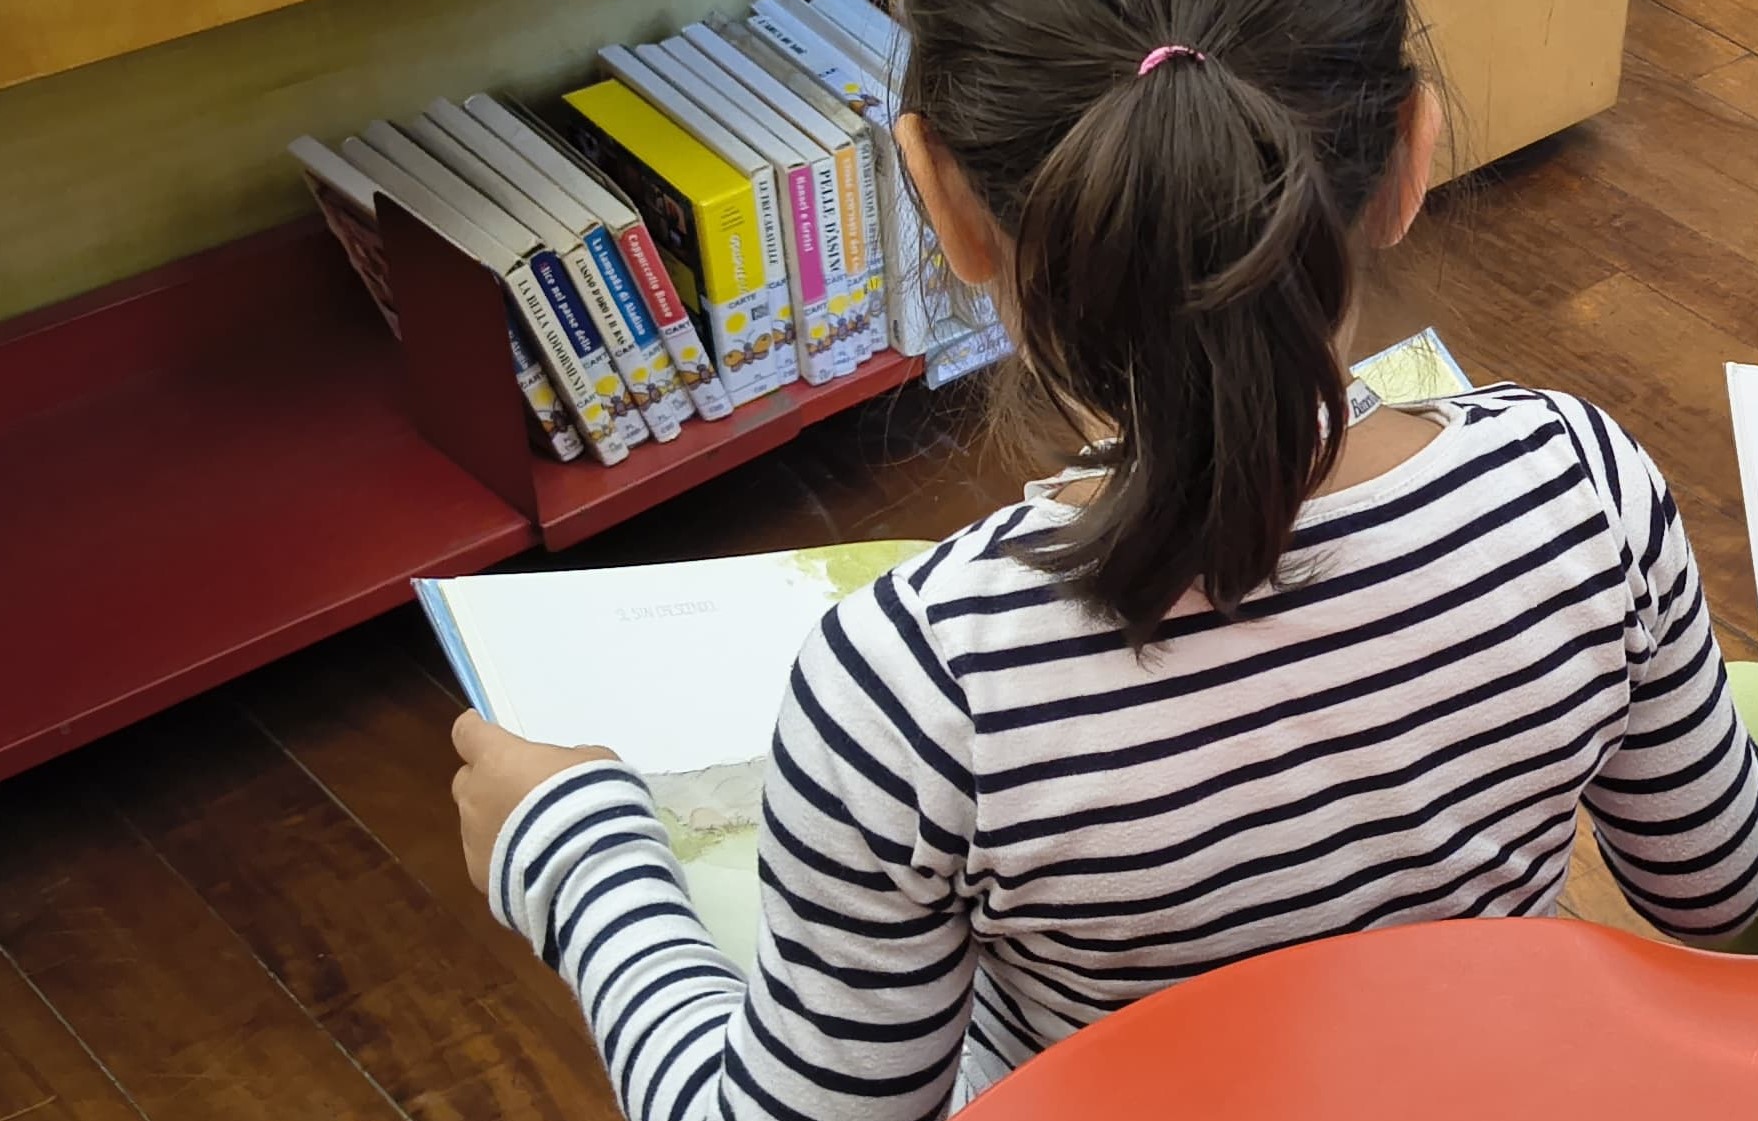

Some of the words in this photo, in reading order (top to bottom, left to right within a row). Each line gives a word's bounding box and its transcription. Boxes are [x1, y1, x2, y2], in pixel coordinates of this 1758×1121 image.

[818, 168, 837, 221] PELLE
[628, 234, 662, 290] Cappuccetto
[762, 207, 779, 267] CARAVELLE
[540, 260, 556, 285] Alice
[551, 281, 564, 299] nel
[558, 296, 580, 329] paese
[574, 328, 592, 353] delle
[598, 252, 624, 292] lampada
[624, 303, 647, 337] Aladino
[729, 293, 757, 310] CARTE
[804, 302, 828, 316] CART
[517, 279, 530, 296] LA
[527, 295, 547, 330] BELLA
[545, 329, 588, 398] ADDORMENT
[583, 352, 609, 370] CART
[615, 344, 635, 358] CAR
